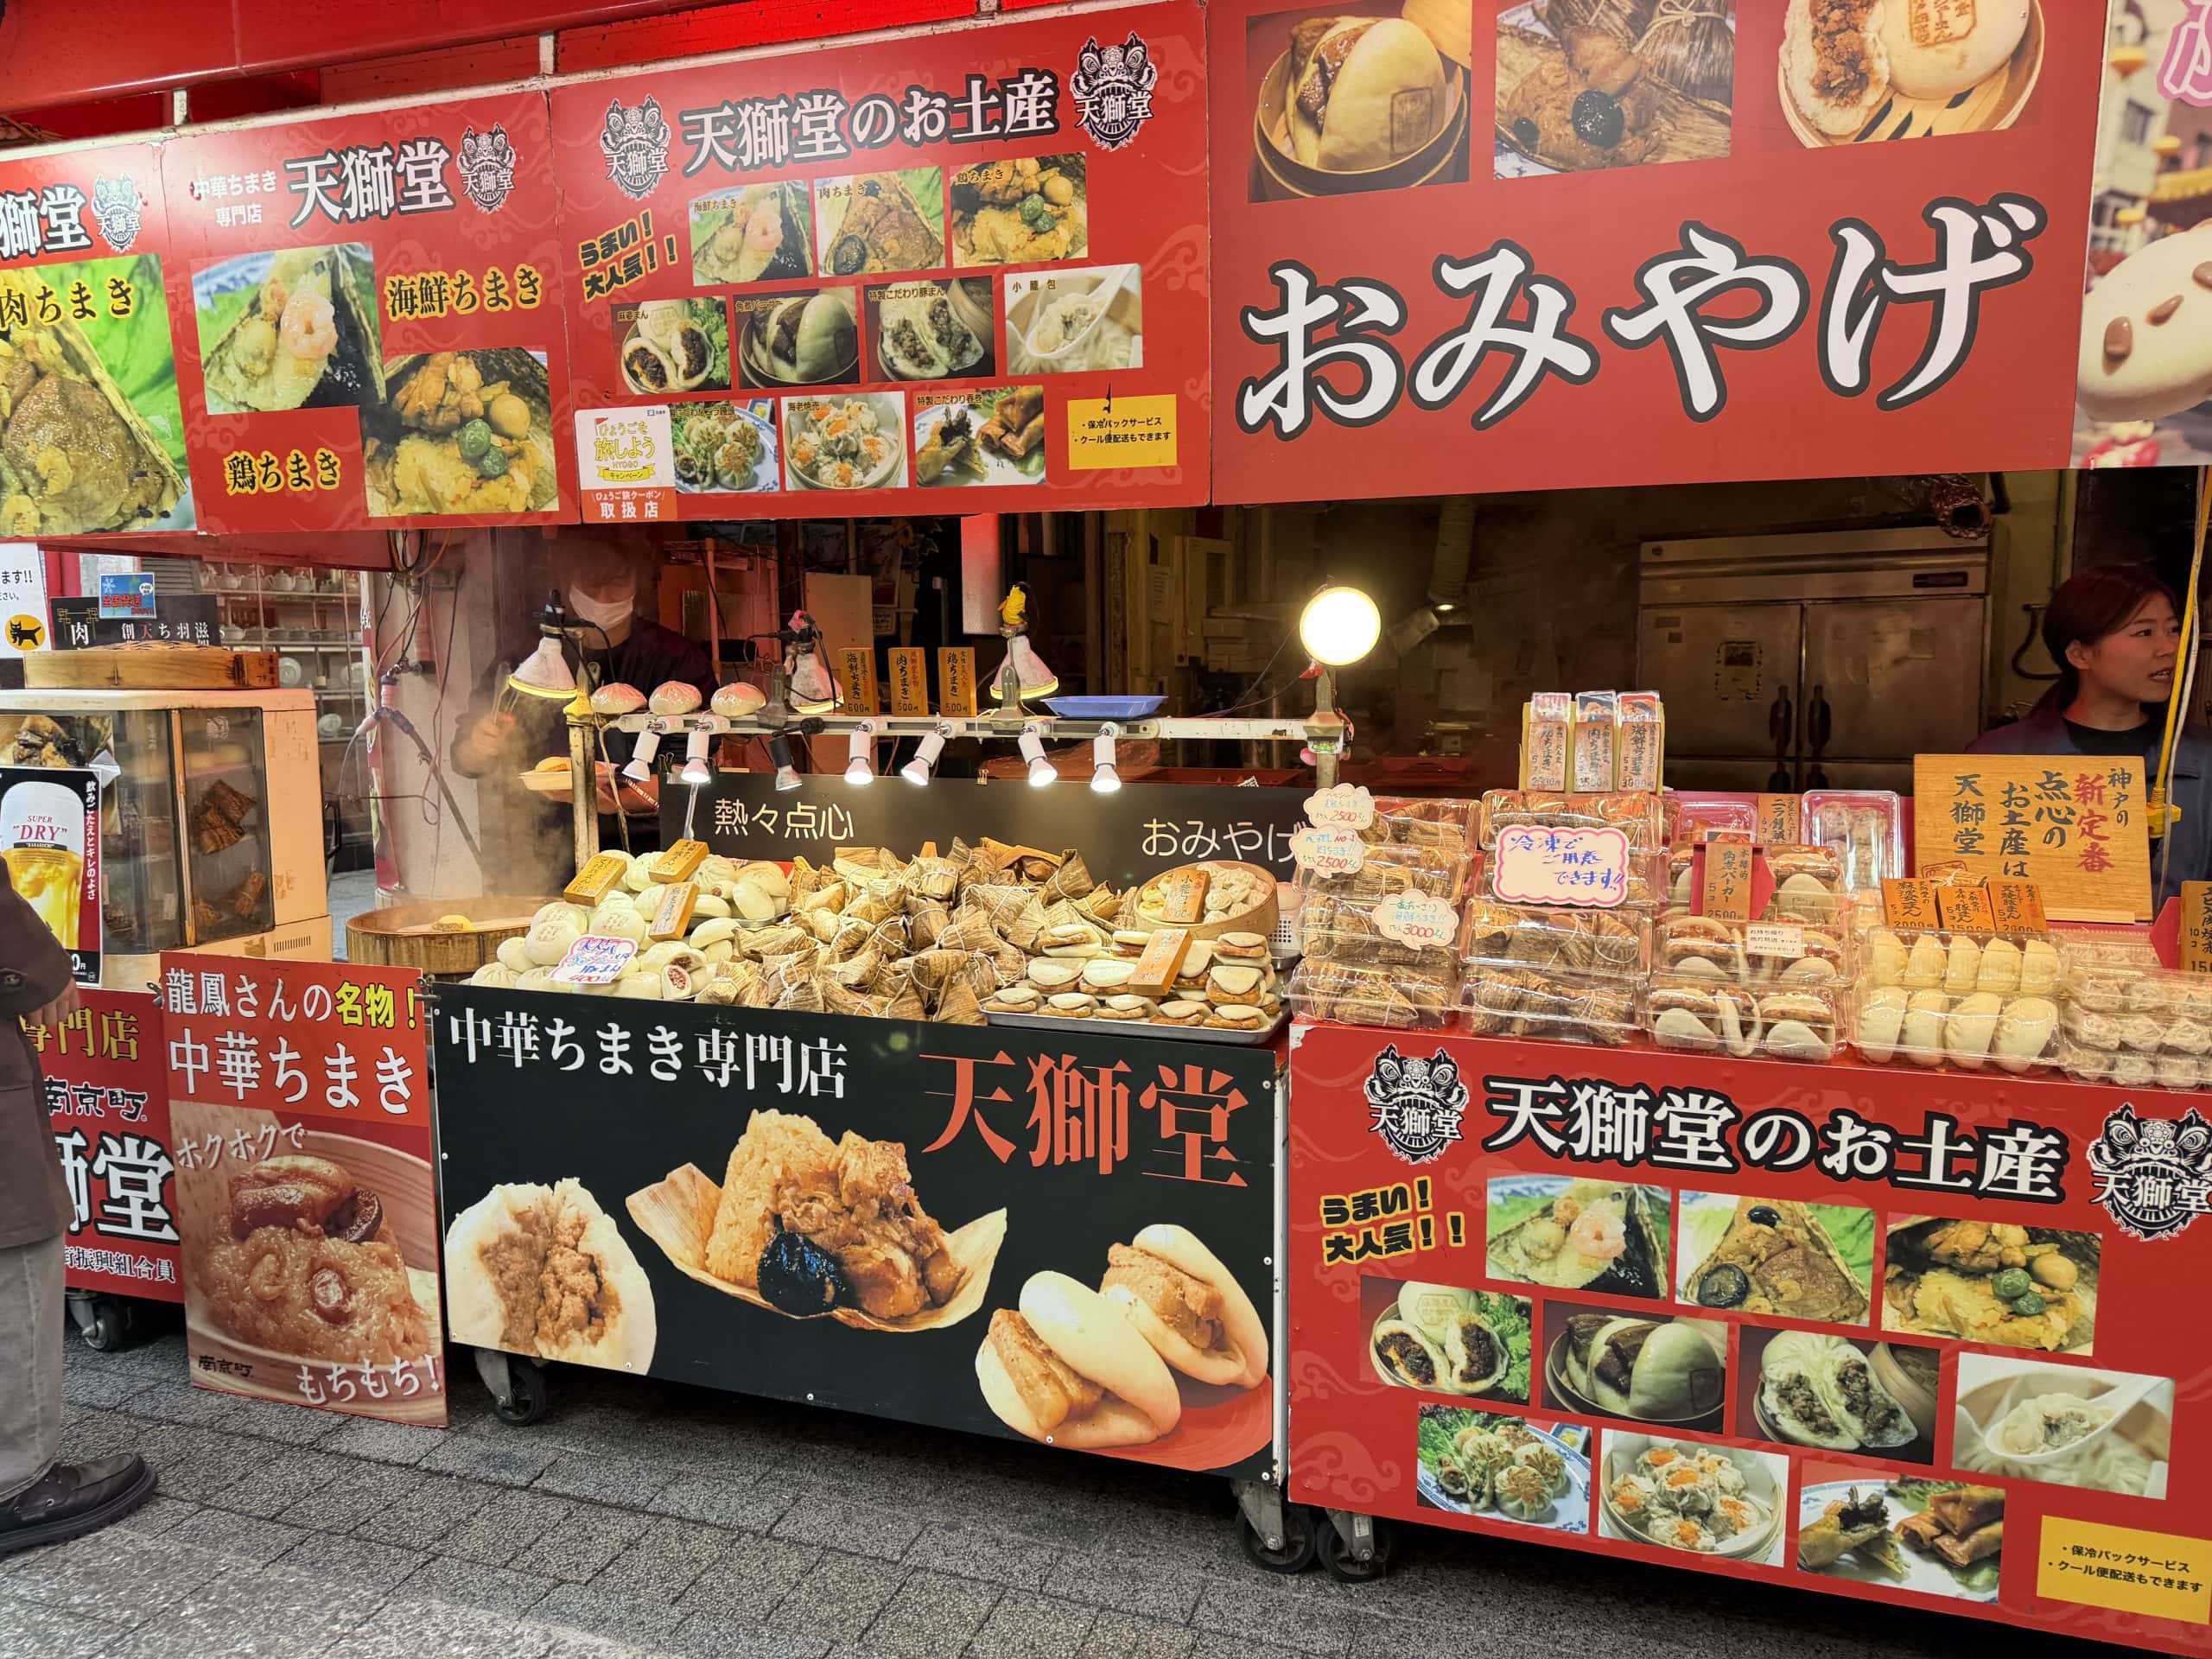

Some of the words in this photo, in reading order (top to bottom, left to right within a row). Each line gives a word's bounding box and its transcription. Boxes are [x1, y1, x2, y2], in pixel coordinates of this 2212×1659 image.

[682, 69, 1059, 173] 天獅堂のお土産
[1074, 88, 1155, 130] 天獅堂
[192, 169, 276, 200] 中華ちまき
[285, 138, 456, 230] 天獅堂
[461, 167, 516, 197] 天獅堂
[605, 144, 671, 181] 天獅堂
[694, 196, 737, 213] 海鮮ちまき
[819, 183, 867, 199] 肉ちまき
[95, 212, 143, 236] 天獅堂
[214, 203, 263, 227] 専門店
[0, 277, 132, 329] 肉ちまき
[386, 264, 543, 321] 海鮮ちまき
[868, 286, 946, 302] 特製こだわり豚まん
[1239, 195, 2046, 438] おみやげ
[917, 393, 983, 406] 特製こだわり春巻
[226, 448, 340, 495] 鶏ちまき
[594, 436, 656, 461] 旅しよう
[601, 501, 658, 518] 取扱店
[896, 654, 910, 701] 肉ちまき
[715, 798, 855, 841] 熱々点心
[1950, 774, 1986, 855] 天獅堂
[2034, 770, 2076, 849] 点心の
[2107, 767, 2133, 828] 神戸の
[1509, 834, 1583, 853] 冷凍で
[1999, 781, 2031, 878] お土産は
[2075, 772, 2115, 874] 新定番
[169, 1028, 415, 1115] 中華ちまき
[449, 1007, 849, 1099] 中華ちまき専門店
[919, 1050, 1249, 1187] 天獅堂
[1369, 1101, 1463, 1142] 天獅堂
[1484, 1077, 2069, 1202] 天獅堂のお土産
[176, 1122, 308, 1170] ホクホクで
[2089, 1168, 2212, 1215] 天獅堂
[296, 1354, 444, 1406] もちもち！
